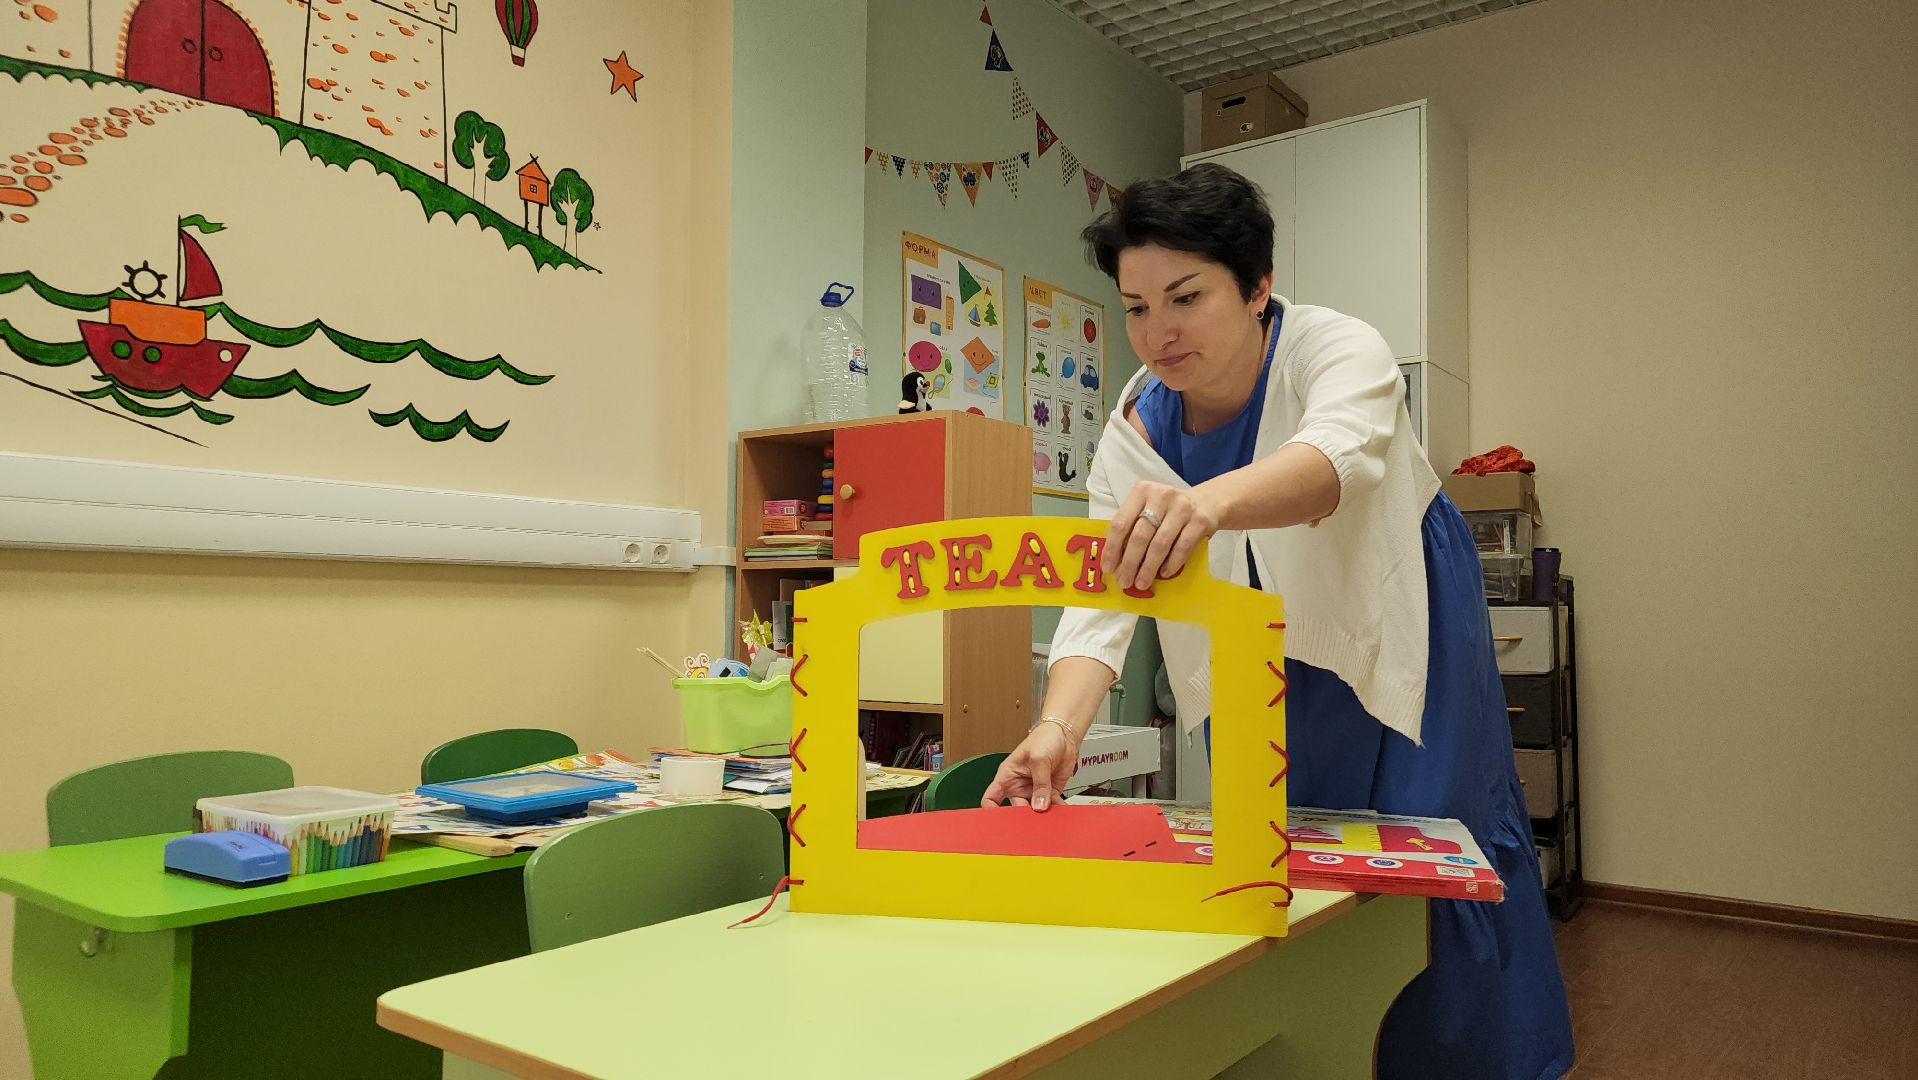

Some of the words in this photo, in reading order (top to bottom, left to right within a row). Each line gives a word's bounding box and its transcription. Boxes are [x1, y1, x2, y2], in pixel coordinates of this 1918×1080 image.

[905, 240, 936, 259] ФОРМА
[881, 532, 1184, 599] ТЕАТ
[1082, 751, 1129, 767] MYPLAYROOM
